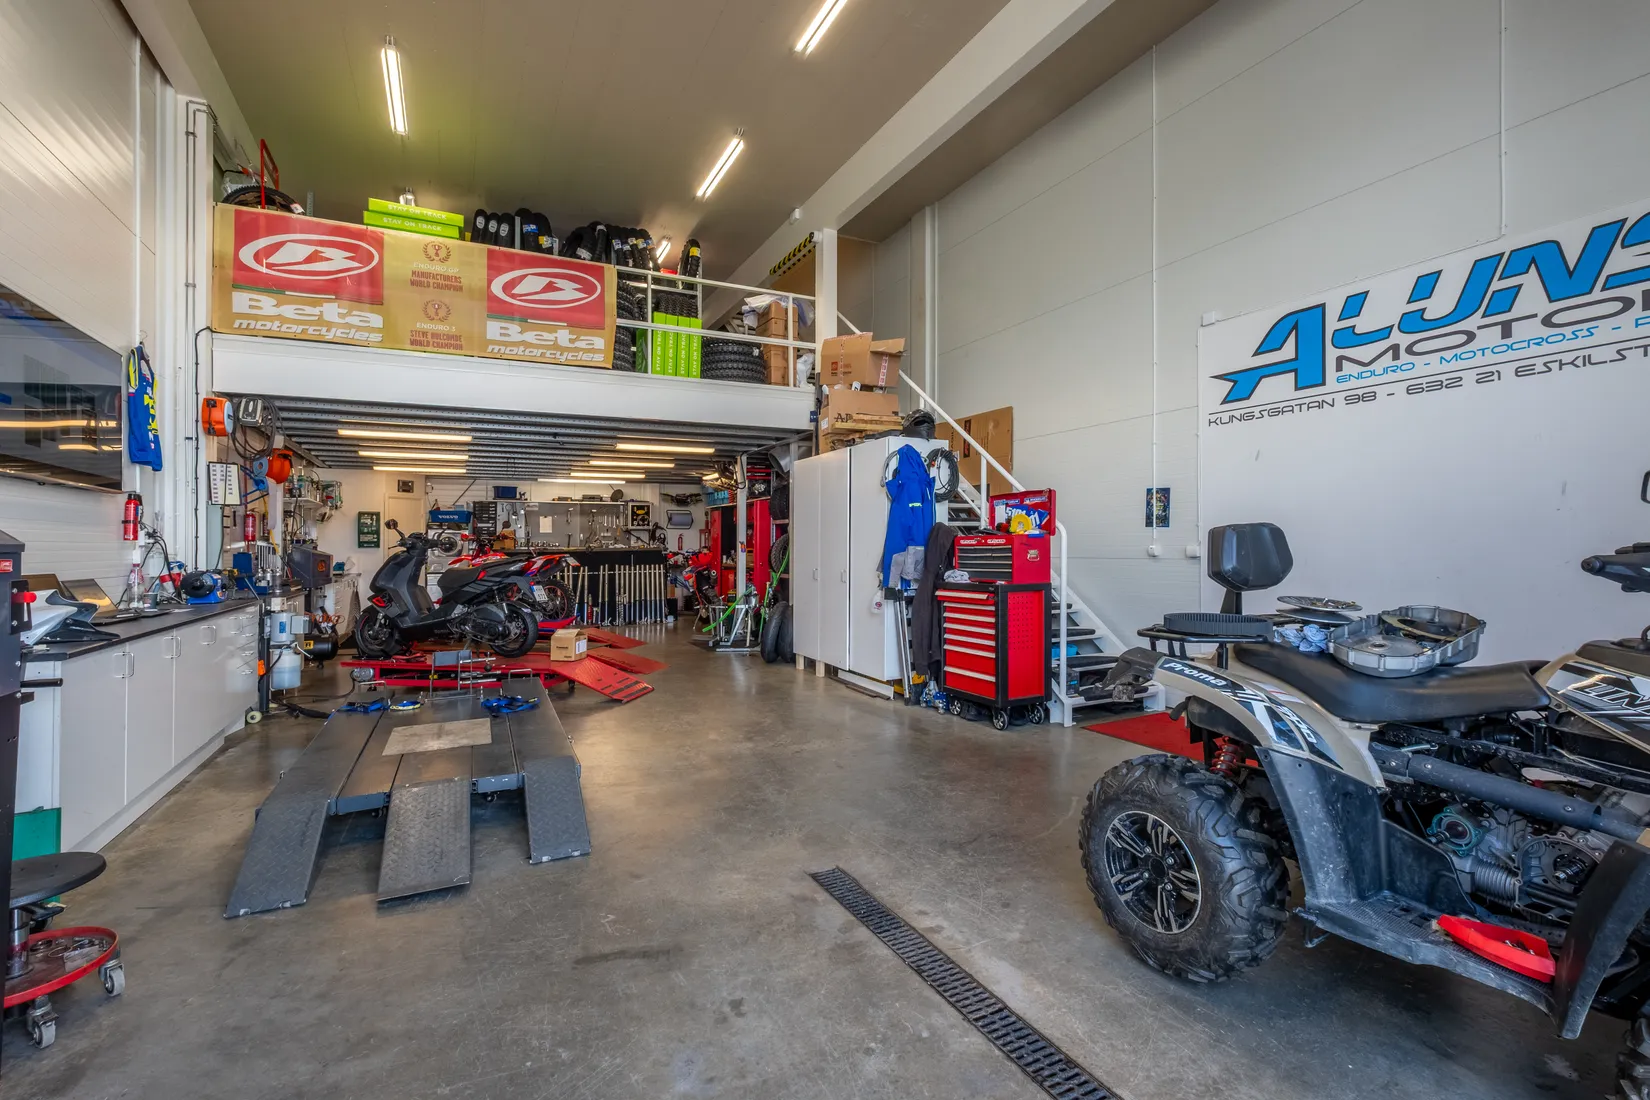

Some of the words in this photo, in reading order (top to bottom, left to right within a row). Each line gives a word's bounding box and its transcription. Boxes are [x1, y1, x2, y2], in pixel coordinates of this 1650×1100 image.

[387, 204, 407, 212] STAY
[423, 211, 447, 220] TRACK
[383, 217, 402, 225] STAY
[418, 223, 442, 231] TRACK
[413, 262, 447, 273] ENDURO
[410, 278, 431, 289] WORLD
[432, 281, 464, 292] CHAMPION
[411, 270, 462, 284] MANUFACTURERS
[232, 291, 384, 329] Beta
[233, 319, 384, 342] motorcycles
[410, 330, 429, 339] STEVE
[416, 322, 450, 331] ENDURO
[1336, 288, 1650, 373] MOTO
[486, 320, 605, 350] Beta
[409, 338, 431, 347] WORLD
[432, 340, 464, 351] CHAMPION
[487, 343, 605, 362] motorcycles
[1336, 361, 1416, 384] ENDURO
[1439, 325, 1599, 365] MOTOCROSS
[1208, 397, 1335, 427] KUNGSGATAN
[1344, 390, 1377, 406] 98
[1406, 376, 1463, 395] 632
[1475, 369, 1502, 384] 21
